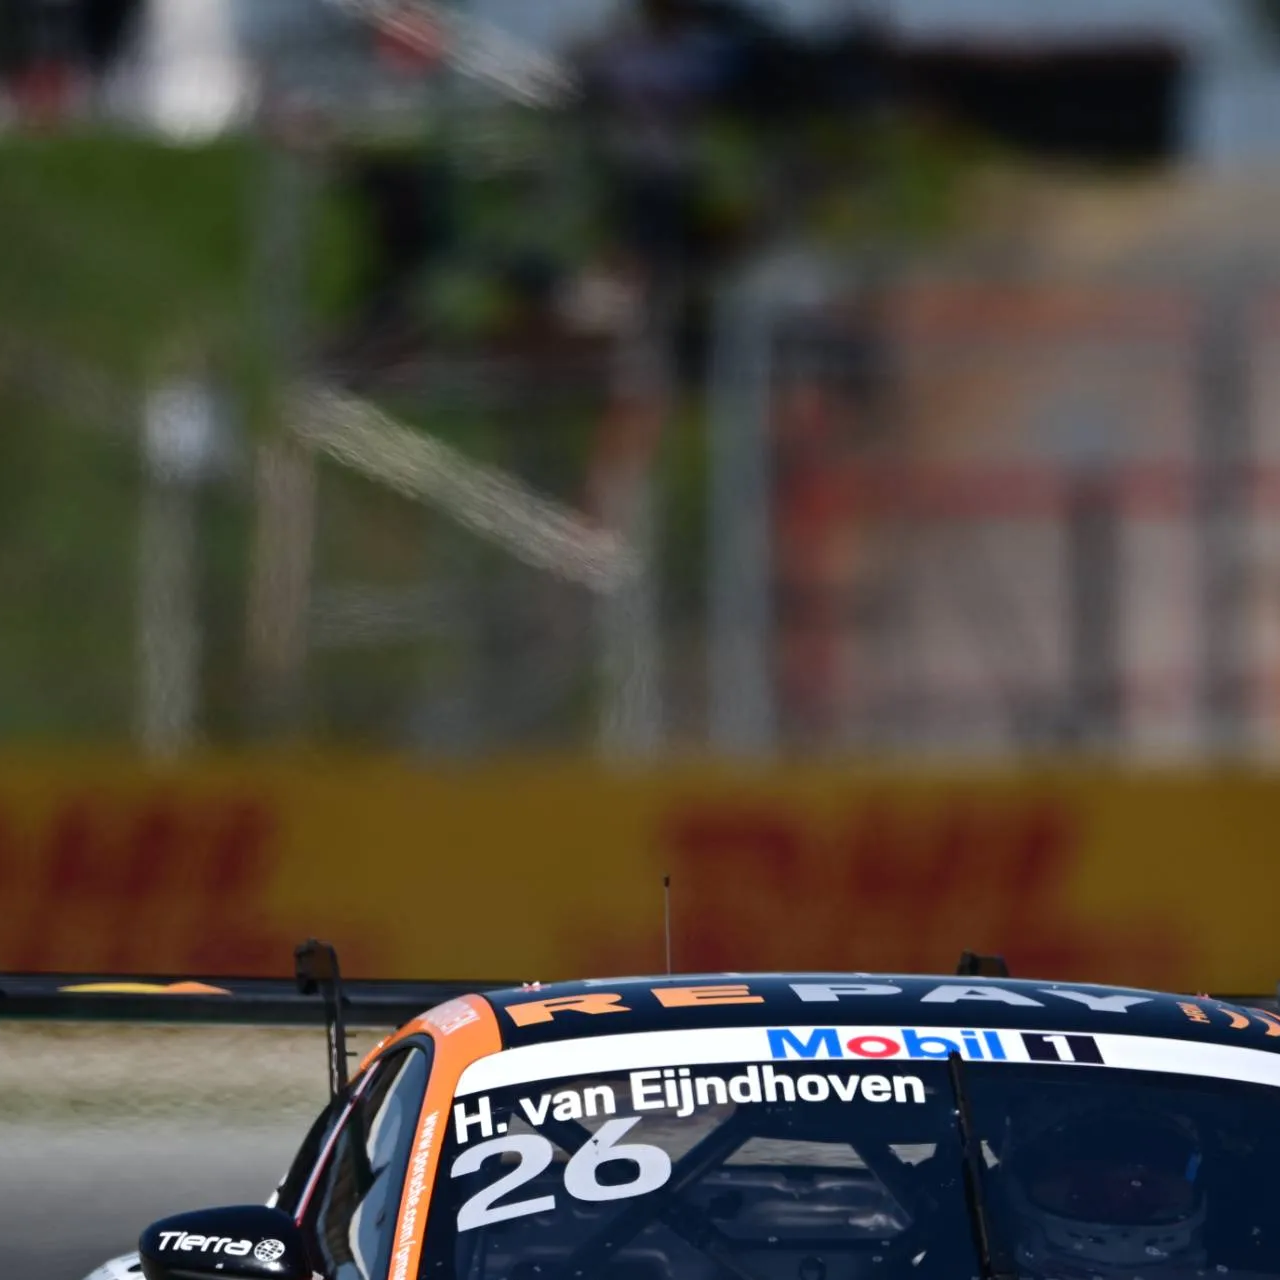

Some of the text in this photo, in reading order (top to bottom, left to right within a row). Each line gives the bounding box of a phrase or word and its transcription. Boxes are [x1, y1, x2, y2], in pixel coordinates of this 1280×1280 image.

[504, 984, 1154, 1027] REPAY
[767, 1028, 1074, 1062] Mobil 1
[454, 1065, 925, 1144] H. van Eijndhoven
[450, 1117, 672, 1232] 26
[158, 1231, 252, 1256] Tierra
